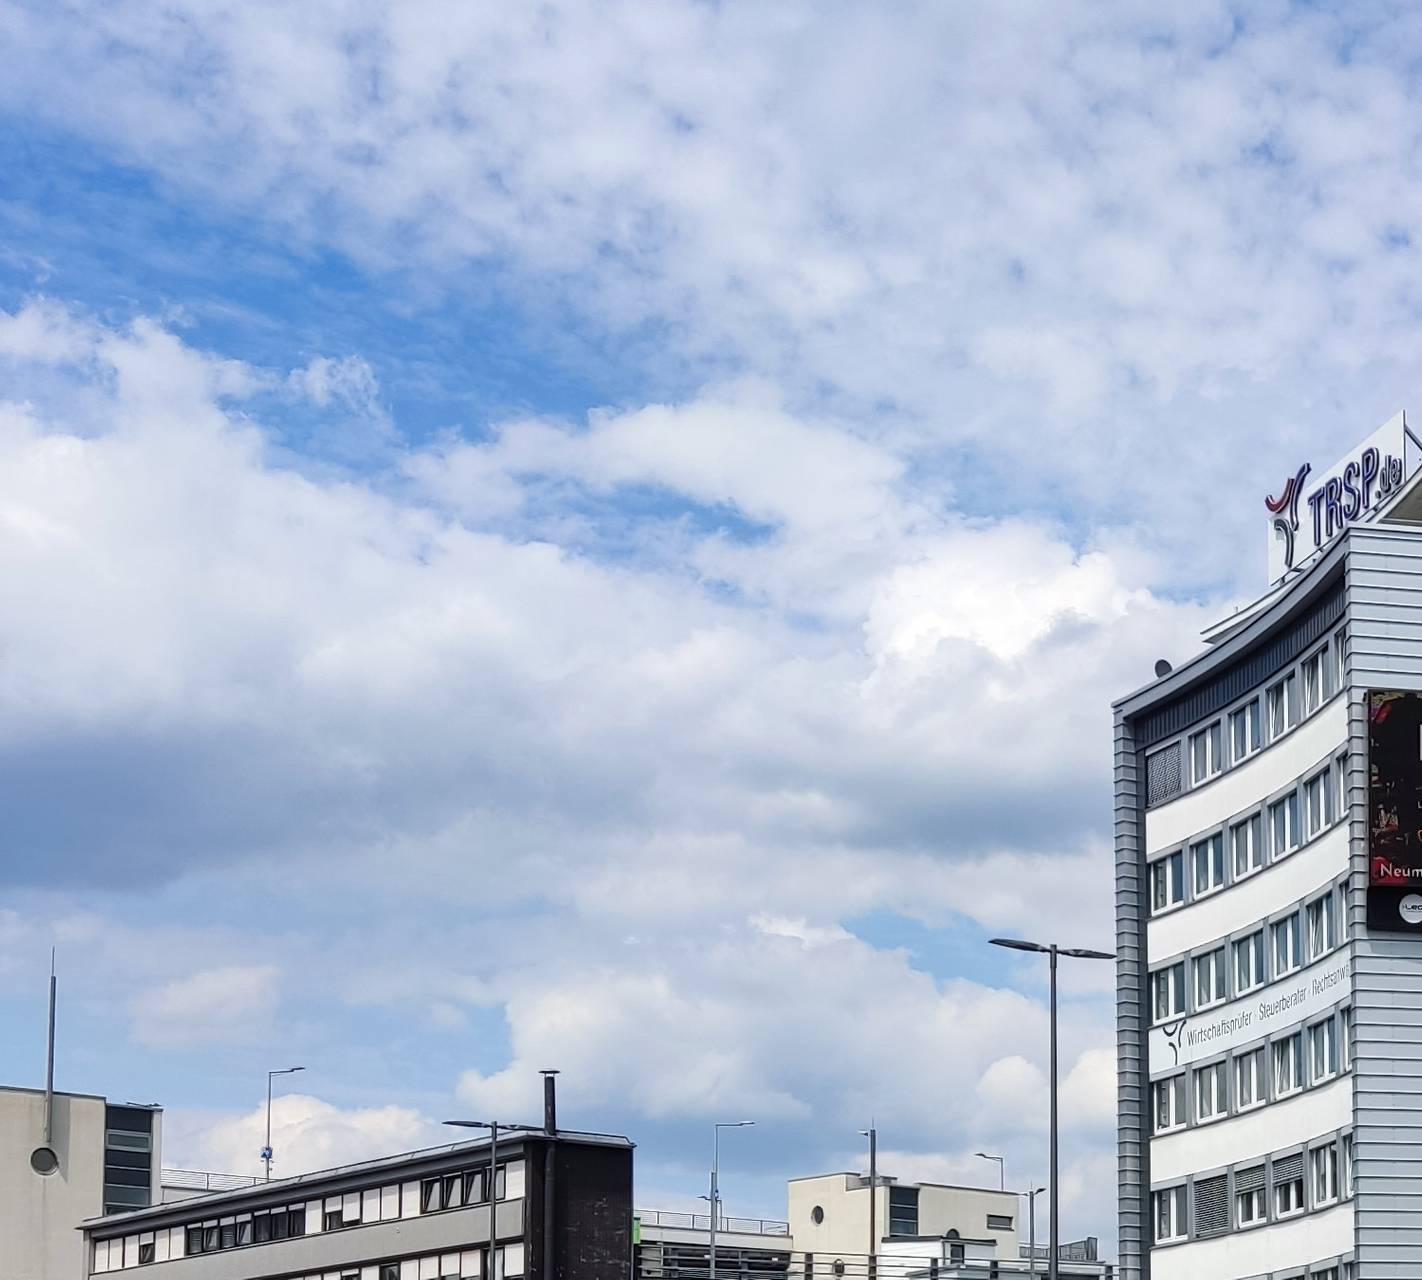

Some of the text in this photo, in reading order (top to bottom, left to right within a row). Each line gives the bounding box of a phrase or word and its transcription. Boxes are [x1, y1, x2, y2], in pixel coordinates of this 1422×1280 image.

[1308, 448, 1402, 547] TRSP.de
[1187, 1011, 1253, 1047] Wirtschaftsprüfer
[1259, 986, 1307, 1021] Steuerberater
